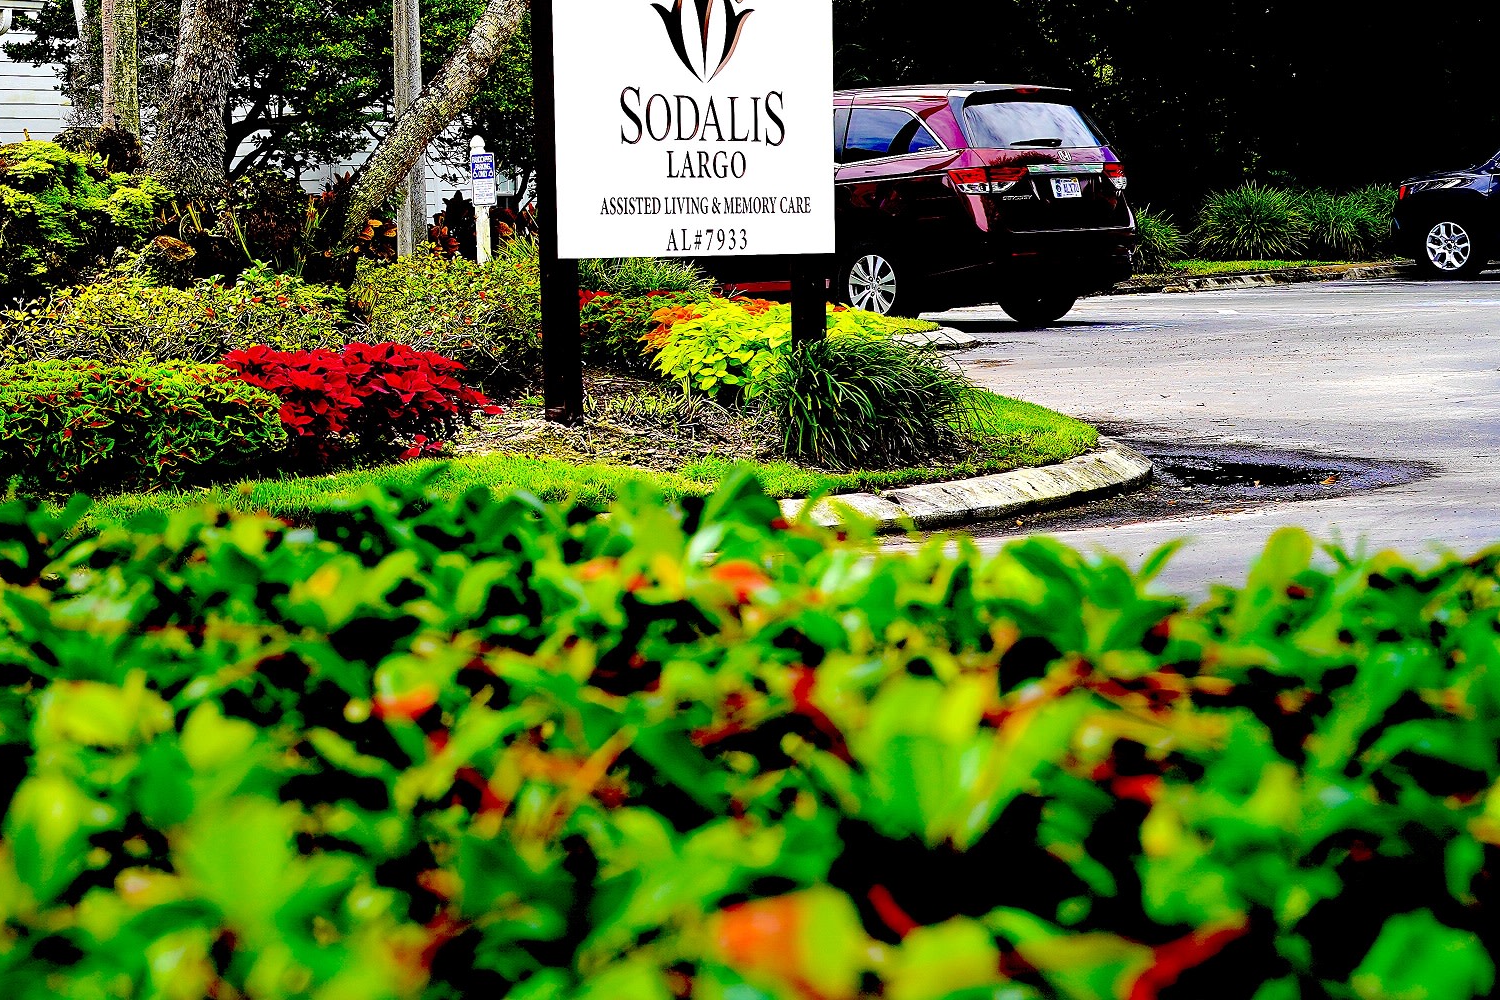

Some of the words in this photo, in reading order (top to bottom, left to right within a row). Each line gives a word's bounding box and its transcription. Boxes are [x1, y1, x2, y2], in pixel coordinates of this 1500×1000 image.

[620, 86, 785, 146] SODALIS
[667, 151, 746, 178] LARGO
[600, 197, 661, 215] ASSISTED
[665, 197, 708, 214] LIVING
[712, 197, 721, 214] &
[724, 197, 777, 214] MEMORY
[780, 197, 811, 213] CARE
[667, 229, 747, 251] AL#7933
